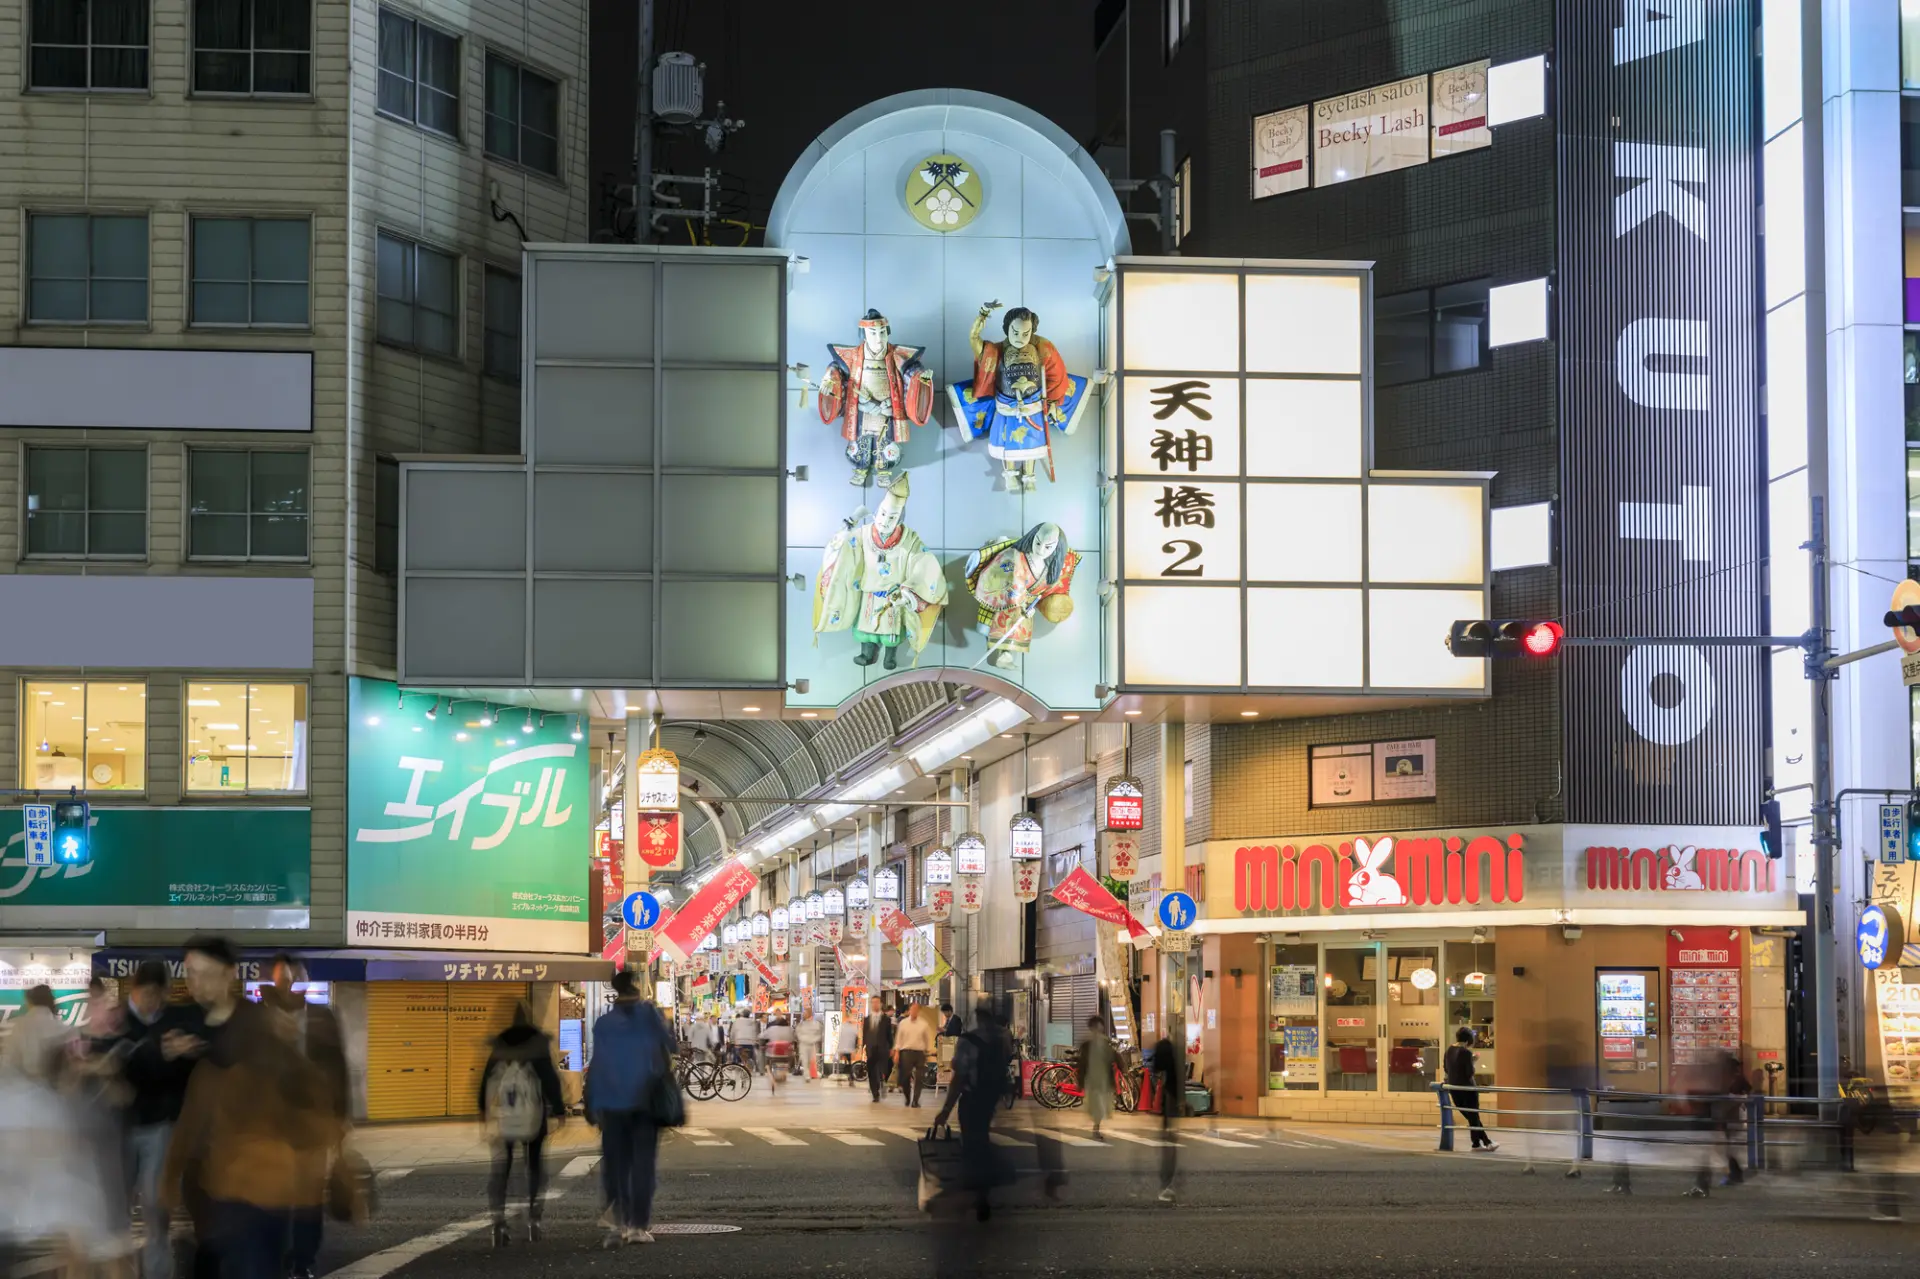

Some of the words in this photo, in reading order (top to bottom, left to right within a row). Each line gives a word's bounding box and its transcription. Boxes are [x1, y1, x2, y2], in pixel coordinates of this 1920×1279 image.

[1448, 80, 1476, 94] Becky
[1318, 90, 1376, 120] eyelash
[1381, 82, 1424, 102] salon
[1268, 127, 1294, 139] Becky
[1318, 122, 1372, 149] Becky
[1380, 109, 1424, 135] Lash
[1271, 136, 1292, 149] Lash
[1150, 381, 1215, 577] 天神橋2
[356, 744, 576, 850] エイブル
[35, 842, 44, 862] 専用
[1888, 840, 1897, 860] 専用
[356, 920, 489, 941] 仲介手数料家賃の半月分
[444, 963, 548, 981] ツチヤスポーツ
